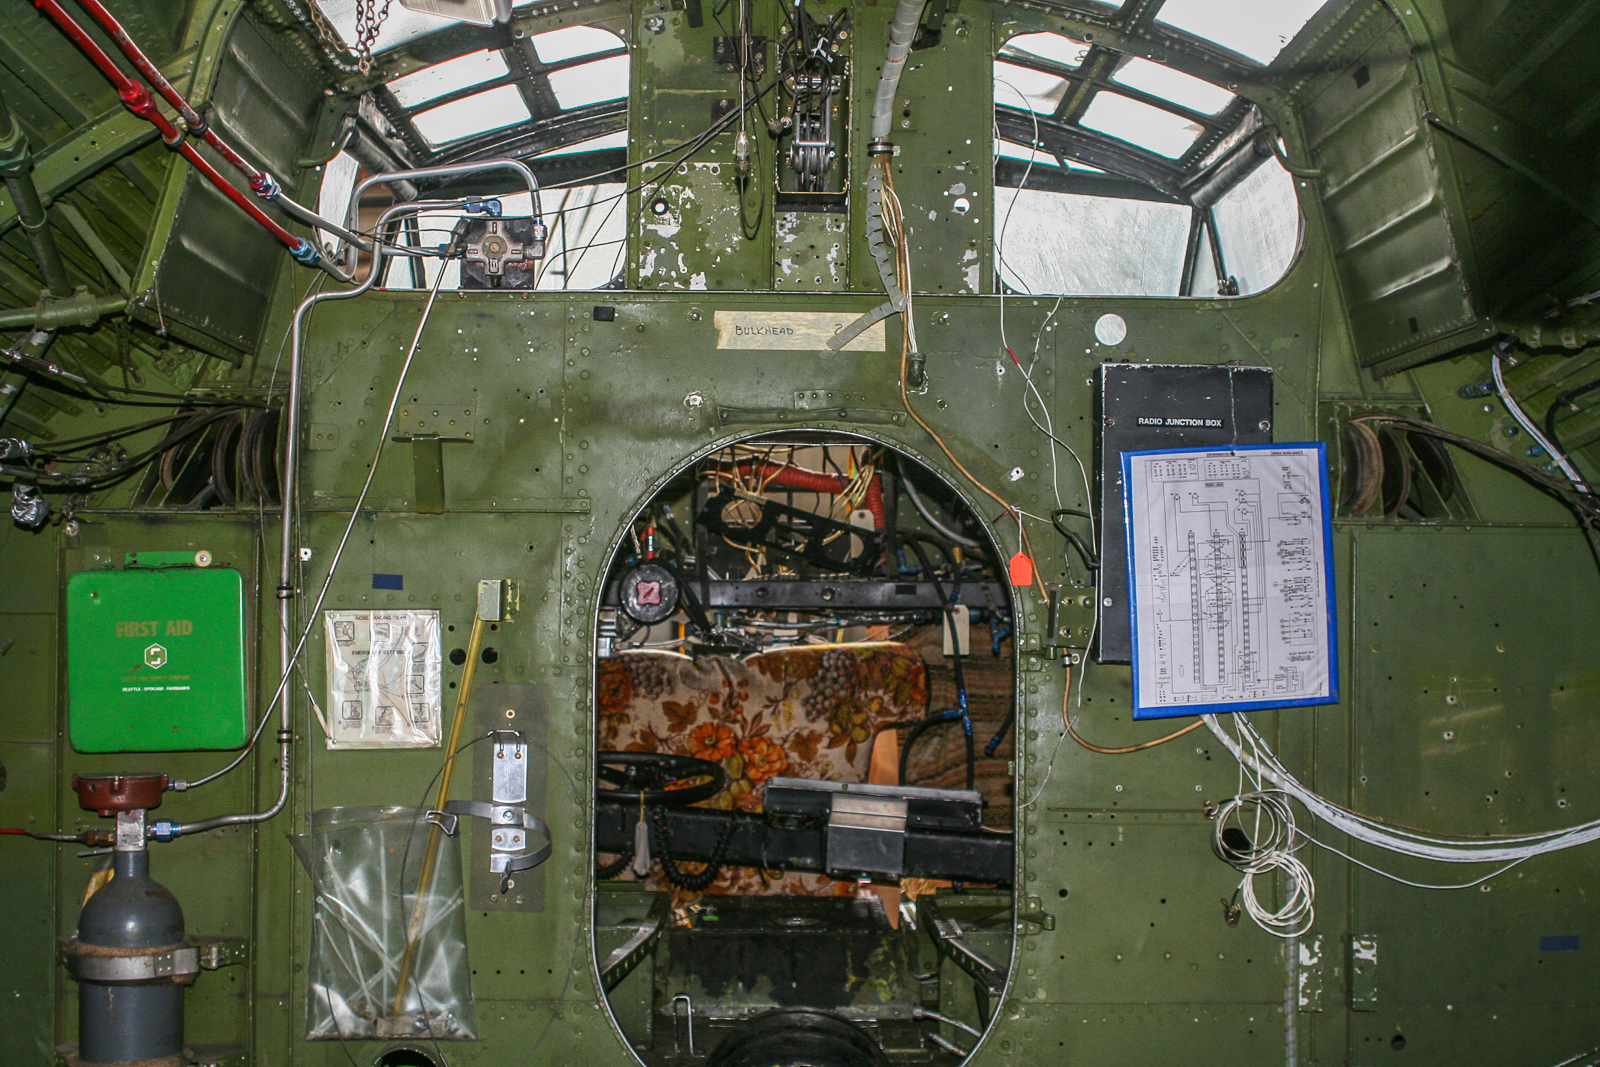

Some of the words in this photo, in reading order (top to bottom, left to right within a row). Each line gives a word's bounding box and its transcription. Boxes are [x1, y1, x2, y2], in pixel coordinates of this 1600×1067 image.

[735, 325, 794, 336] BULKHEAD
[1138, 417, 1163, 425] RADIO
[1165, 418, 1204, 426] JUNCTION
[1205, 419, 1222, 427] BOX
[116, 621, 159, 637] FIRST
[165, 619, 193, 636] AID
